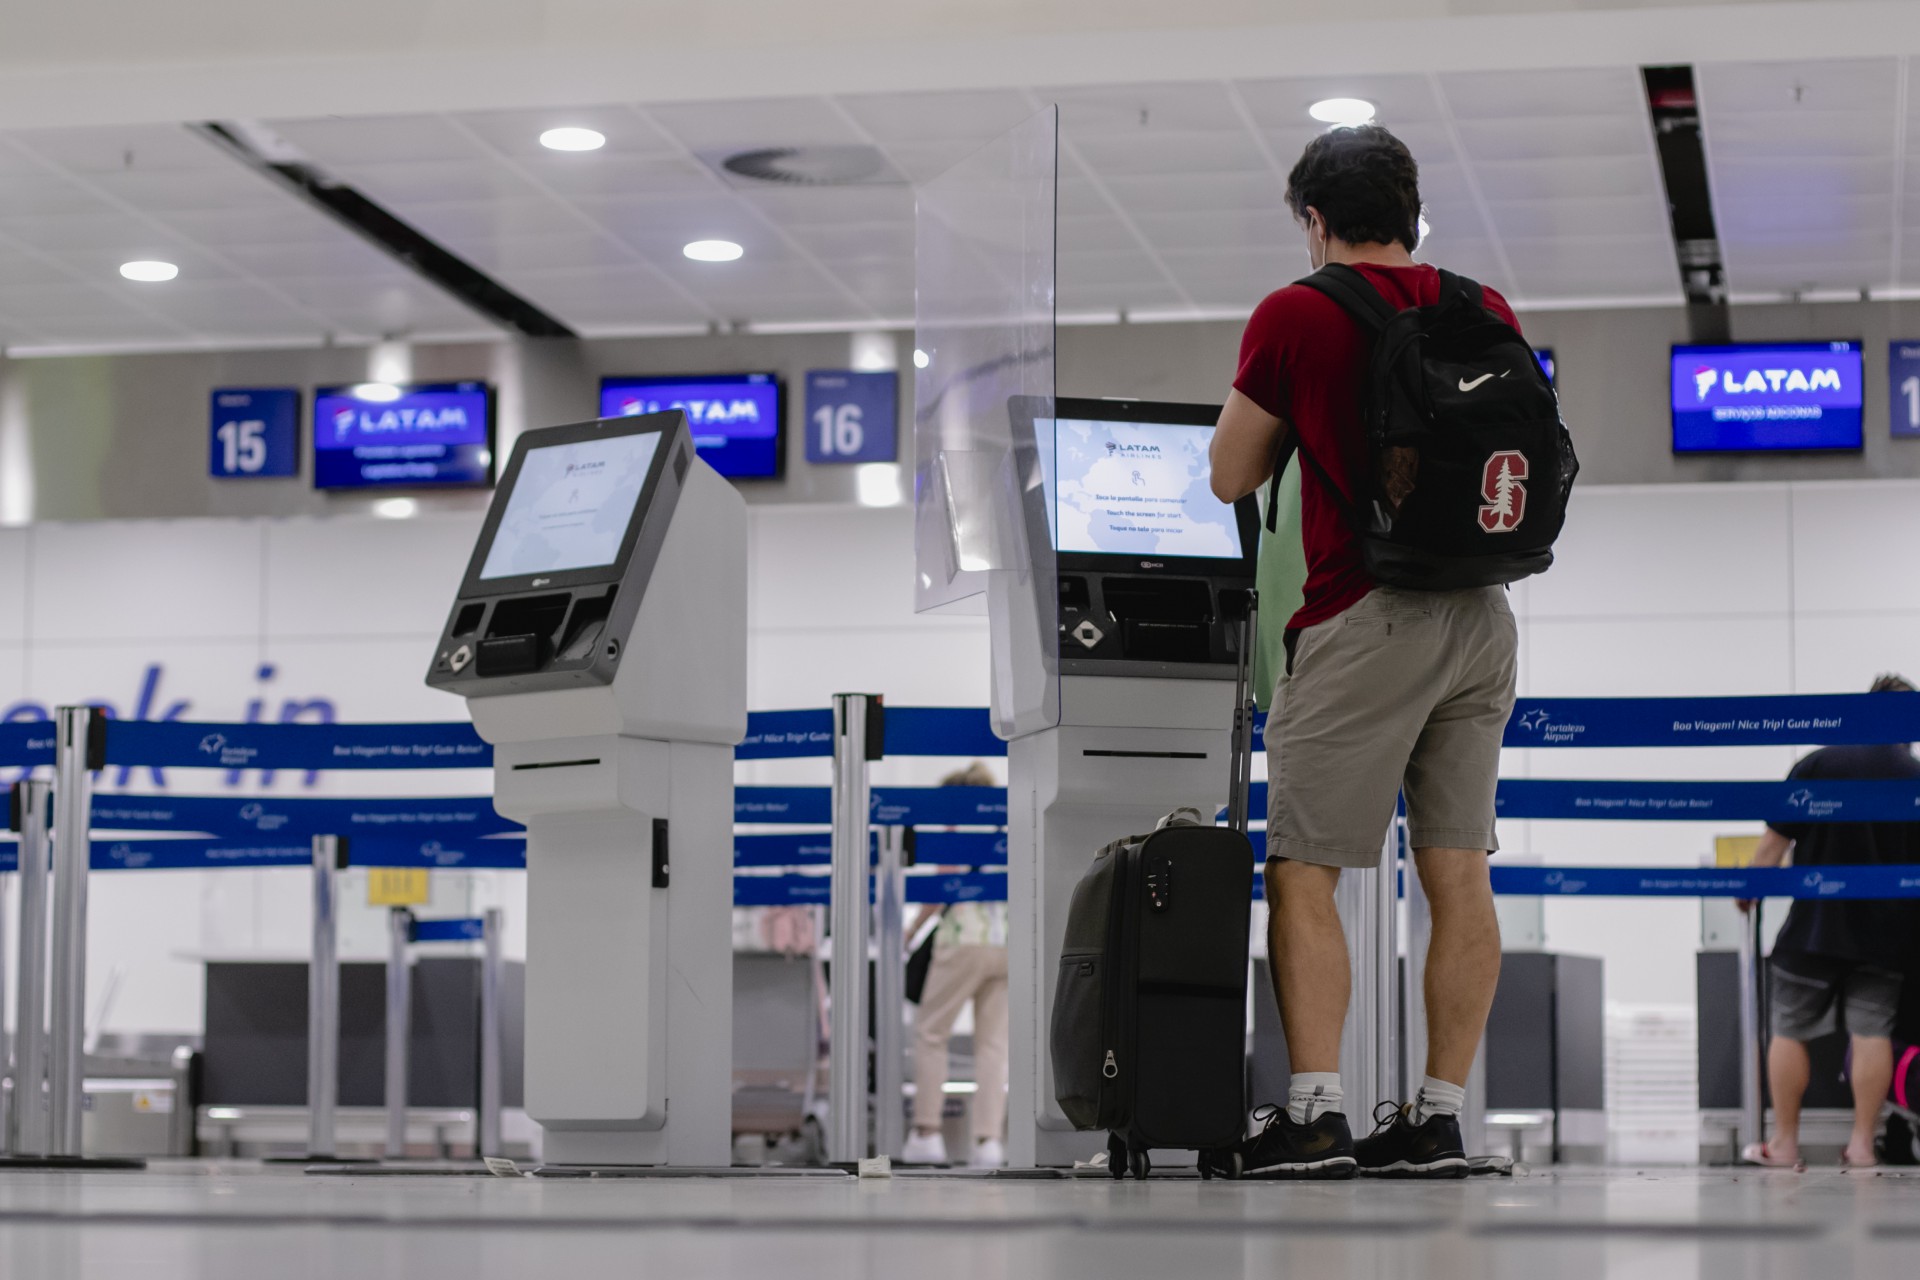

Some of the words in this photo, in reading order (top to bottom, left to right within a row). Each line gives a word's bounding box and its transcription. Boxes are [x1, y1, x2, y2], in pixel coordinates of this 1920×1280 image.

[1723, 368, 1841, 394] LATAM
[1900, 375, 1920, 428] 1
[359, 407, 468, 434] LATAM
[813, 403, 864, 457] 16
[217, 419, 267, 473] 15
[1119, 444, 1161, 452] LATAM
[1543, 732, 1574, 743] Airport
[1545, 723, 1585, 733] Fortaleza
[1673, 721, 1692, 731] Boa
[1694, 720, 1735, 733] Viagem!
[1738, 720, 1760, 730] Nice
[1762, 718, 1785, 731] Trip!
[1787, 718, 1810, 729] Gute
[1813, 717, 1842, 728] Reise!
